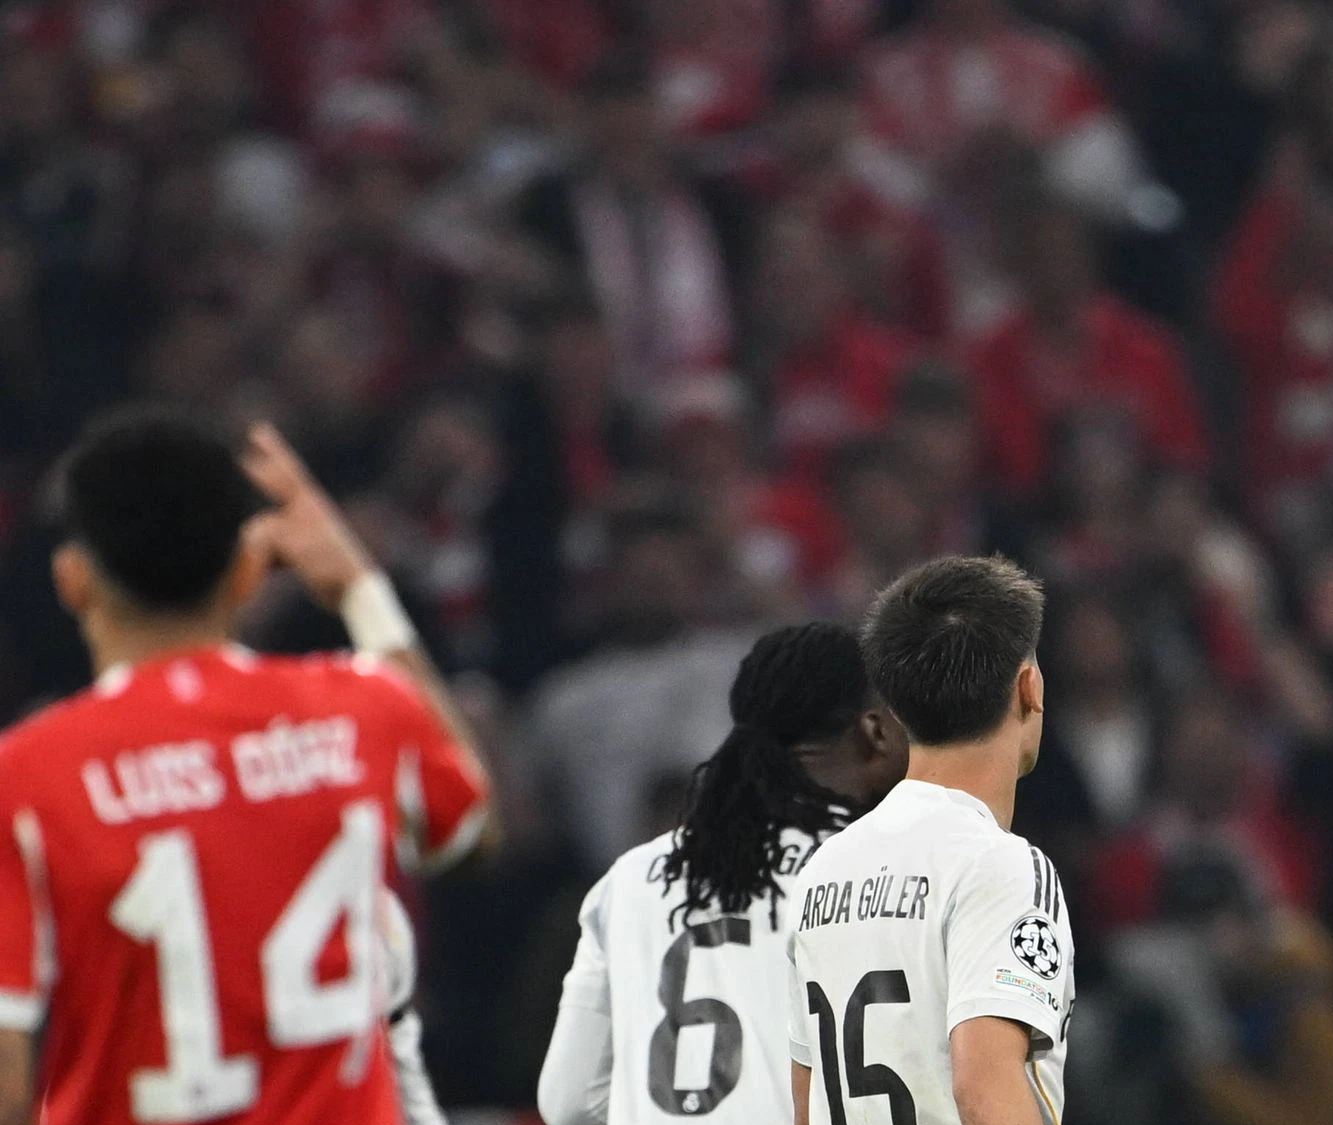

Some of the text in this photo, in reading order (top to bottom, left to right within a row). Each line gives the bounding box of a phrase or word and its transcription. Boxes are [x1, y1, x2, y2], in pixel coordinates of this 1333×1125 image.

[799, 865, 929, 933] ARDA GÜLER
[647, 916, 751, 1117] 6
